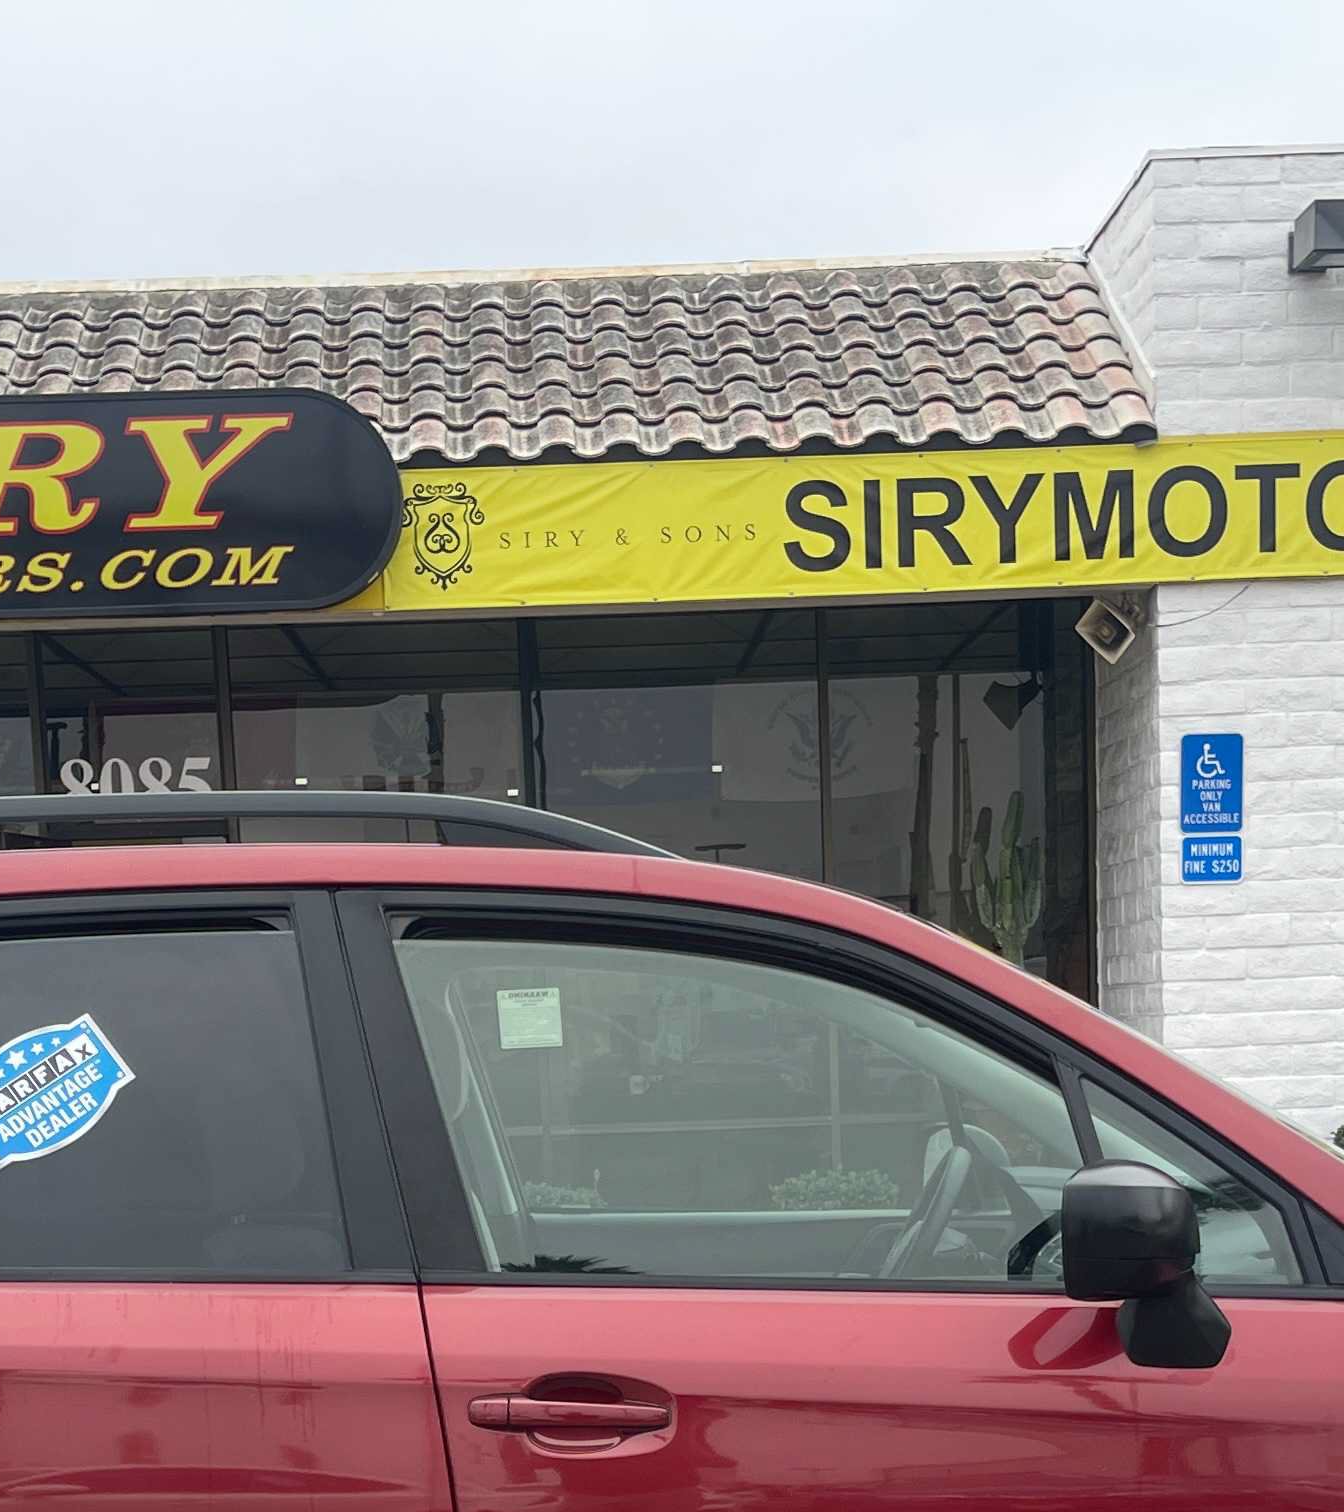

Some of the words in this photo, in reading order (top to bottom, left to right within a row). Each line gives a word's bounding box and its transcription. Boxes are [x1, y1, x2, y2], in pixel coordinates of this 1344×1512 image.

[499, 529, 585, 550] SIRY
[615, 527, 631, 546] &
[660, 523, 757, 544] SONS
[1191, 779, 1232, 790] PARKING
[1200, 790, 1223, 802] ONLY
[1202, 802, 1221, 812] VAN
[1183, 812, 1240, 825] ACCESSIBLE
[1190, 843, 1234, 857] MINIMUM
[1184, 860, 1206, 874] FINE
[1212, 859, 1240, 873] $250
[24, 1091, 99, 1148] DEALER
